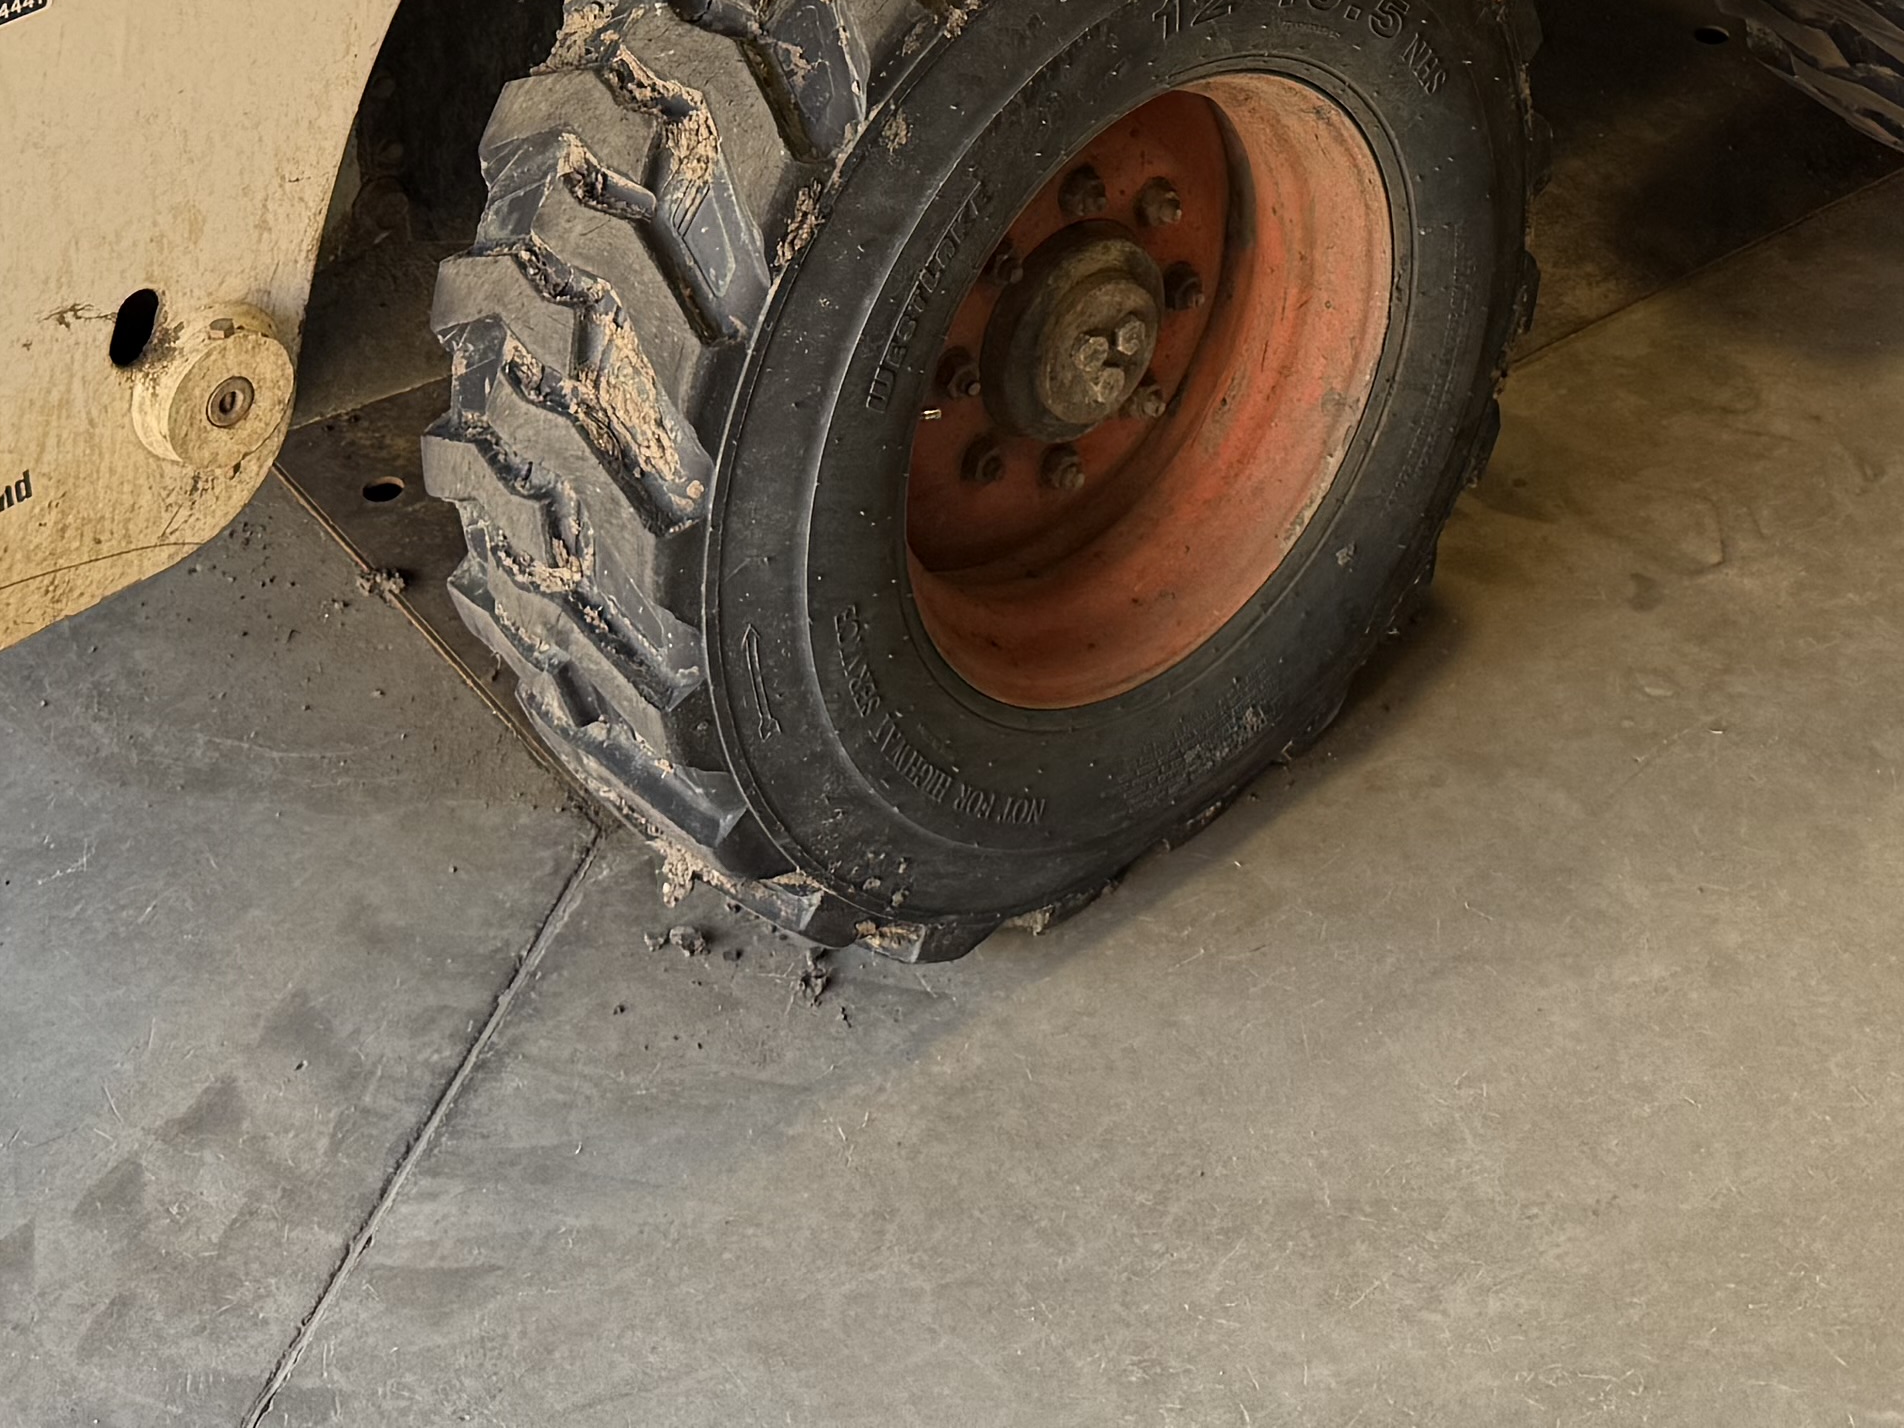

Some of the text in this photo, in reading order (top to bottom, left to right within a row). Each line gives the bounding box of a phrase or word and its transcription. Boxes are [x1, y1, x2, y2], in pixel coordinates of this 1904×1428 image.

[1400, 32, 1447, 95] NHS
[867, 712, 954, 804] HIGHWAY
[953, 783, 997, 819] FOR
[997, 796, 1046, 825] NOT
